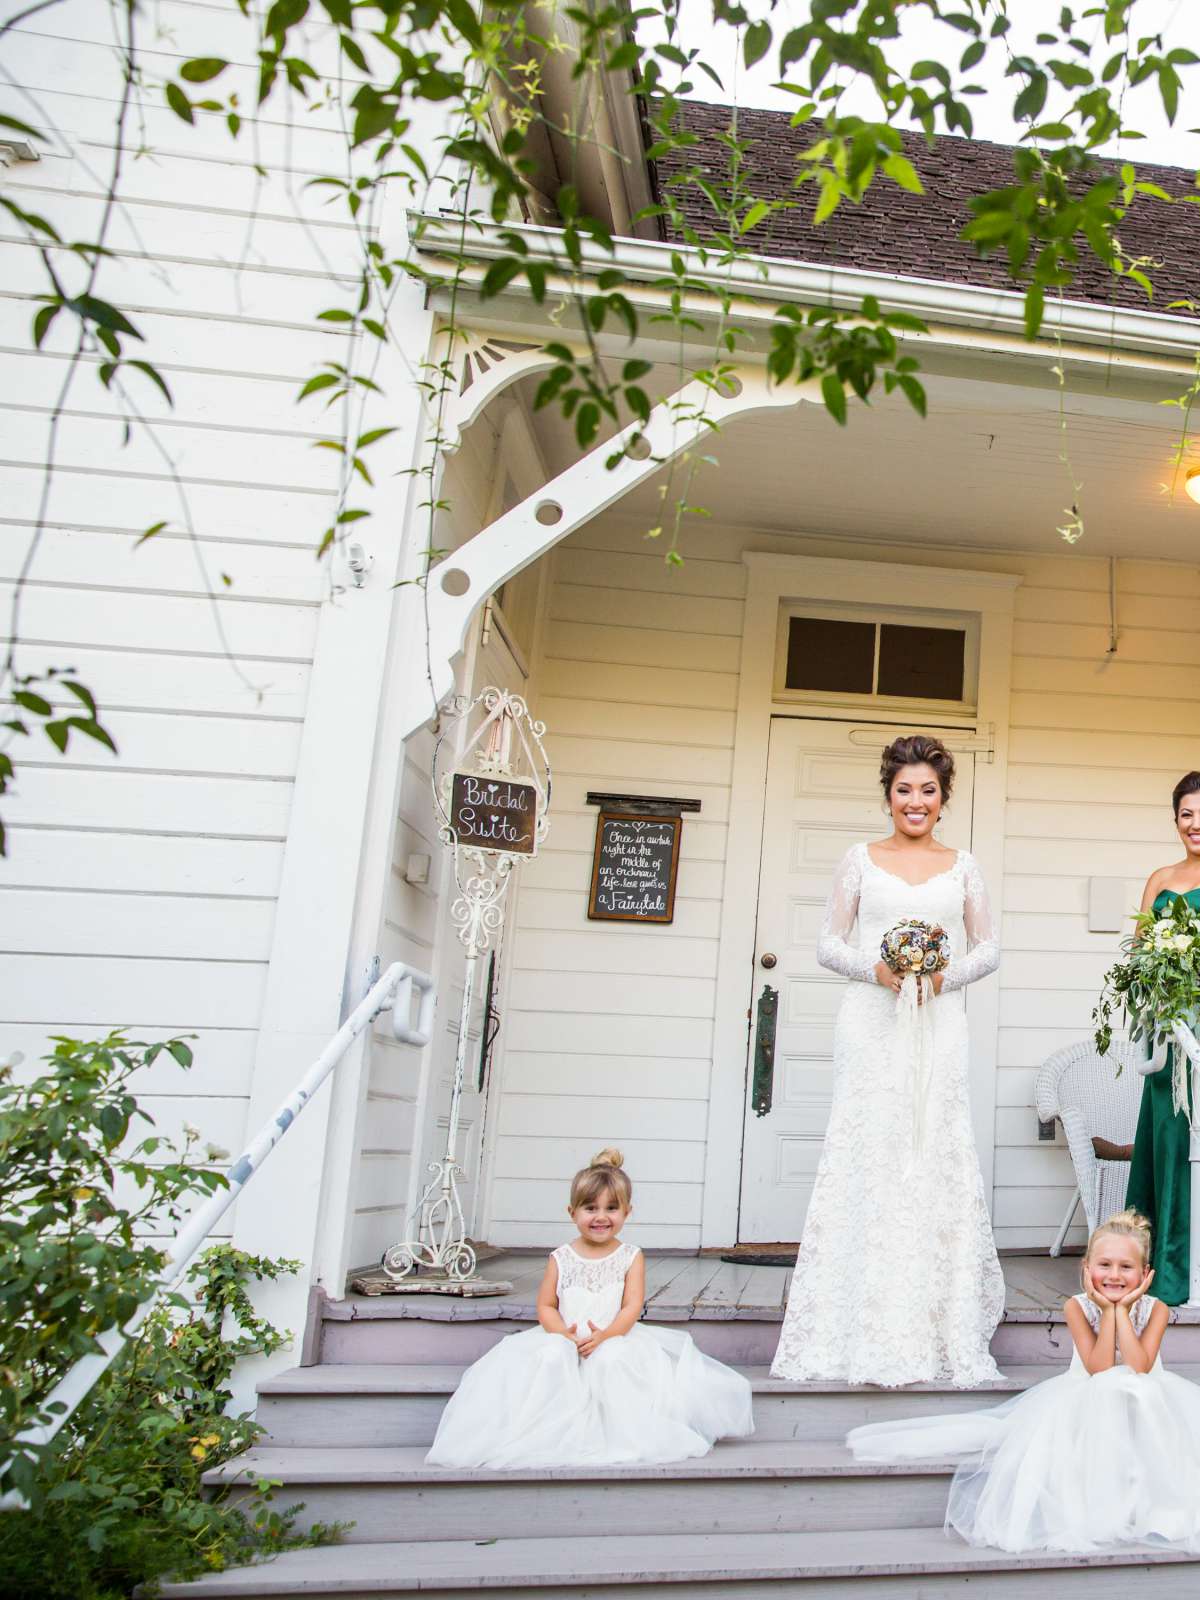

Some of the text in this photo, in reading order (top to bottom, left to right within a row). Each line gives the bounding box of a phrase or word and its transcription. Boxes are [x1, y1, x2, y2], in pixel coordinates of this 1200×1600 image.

[463, 777, 528, 811] Bridal
[458, 808, 530, 841] Suite
[610, 831, 634, 843] Once
[636, 835, 645, 843] in
[603, 843, 652, 857] right in the
[621, 856, 662, 870] middle of
[600, 867, 657, 880] an ordinary
[623, 879, 637, 888] love
[640, 881, 657, 892] gives
[599, 892, 665, 915] a Fairytale
